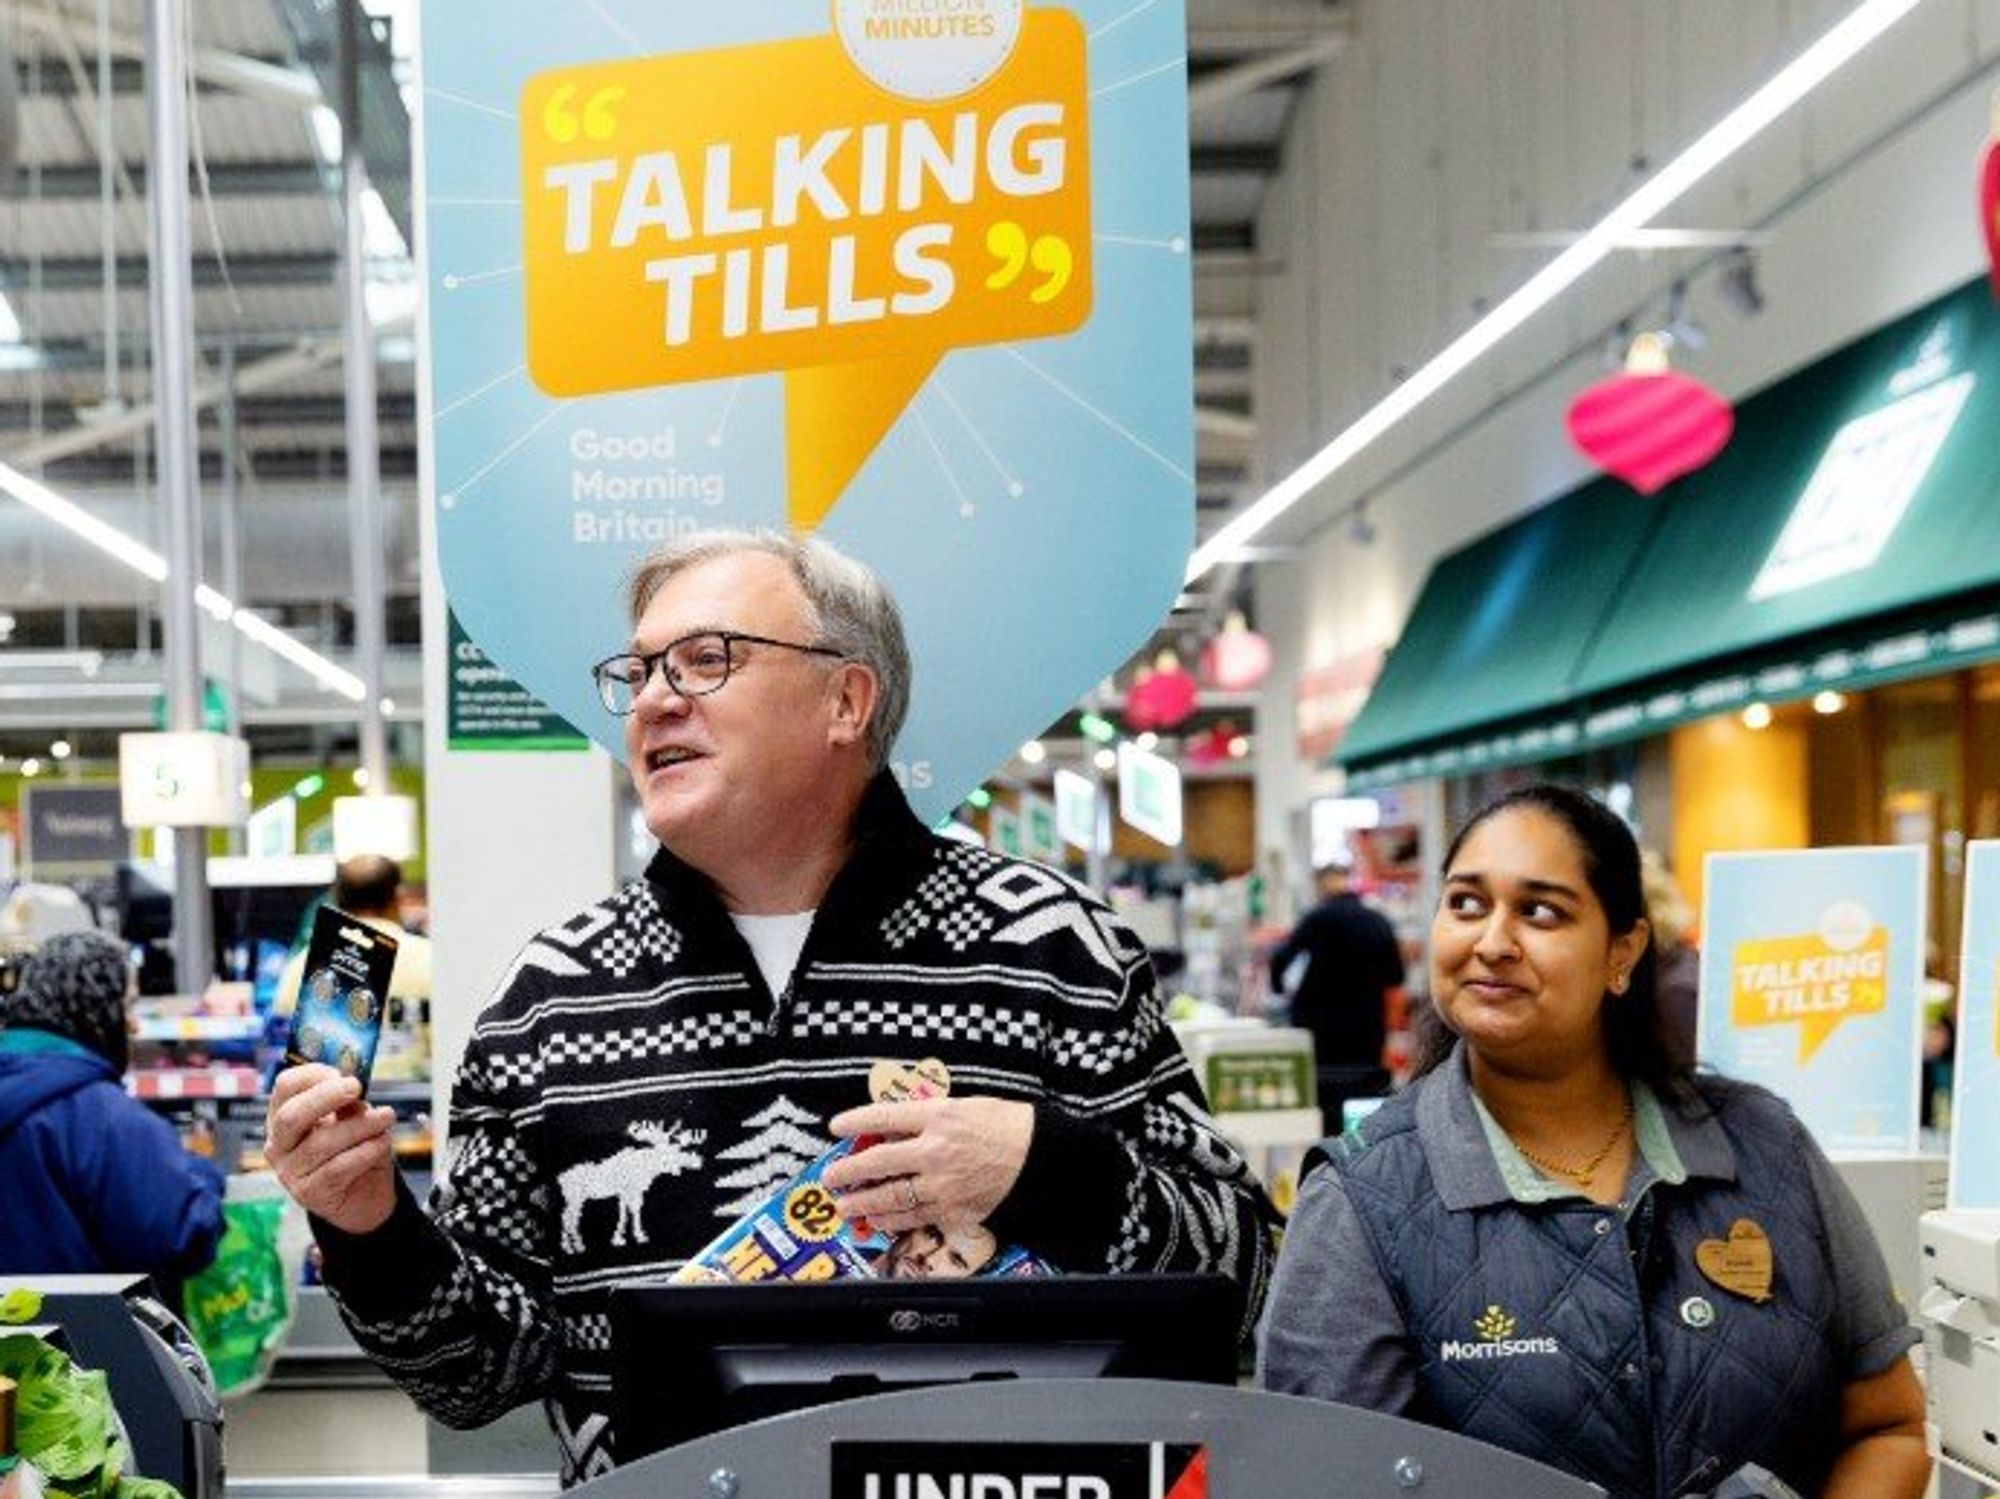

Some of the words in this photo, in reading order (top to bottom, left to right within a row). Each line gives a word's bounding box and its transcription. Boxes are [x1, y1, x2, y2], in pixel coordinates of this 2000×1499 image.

[865, 14, 995, 39] MINUTES
[545, 101, 1067, 255] TALKING
[645, 222, 957, 347] TILLS
[570, 426, 676, 460] Good
[572, 468, 725, 506] Morning
[156, 764, 179, 798] 5
[1737, 950, 1883, 992] TALKING
[1764, 982, 1850, 1018] TILLS
[1441, 1336, 1559, 1362] Morrisons
